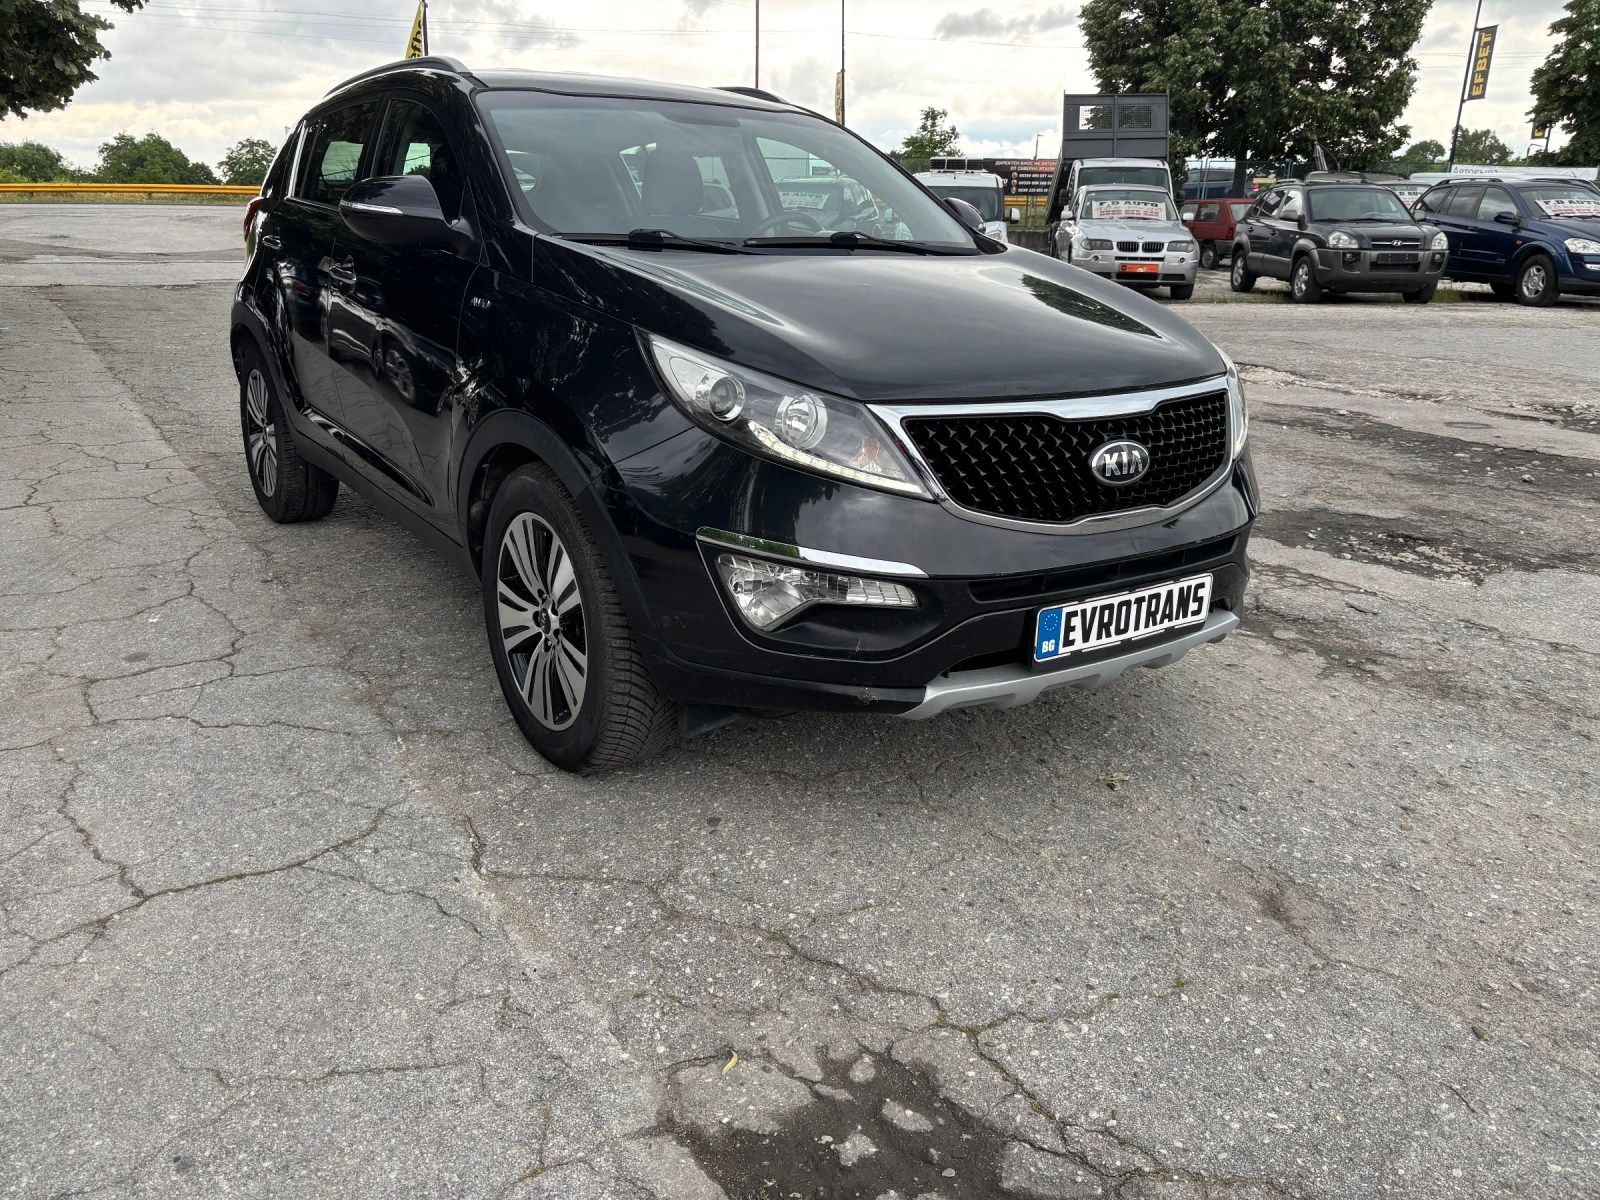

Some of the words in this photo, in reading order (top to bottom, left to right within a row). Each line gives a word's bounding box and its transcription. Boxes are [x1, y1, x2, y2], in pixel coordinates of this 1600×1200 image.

[1471, 32, 1493, 97] EFBET
[1104, 450, 1143, 477] KIA
[1062, 582, 1206, 648] EVROTRANS
[1041, 639, 1055, 653] BG
